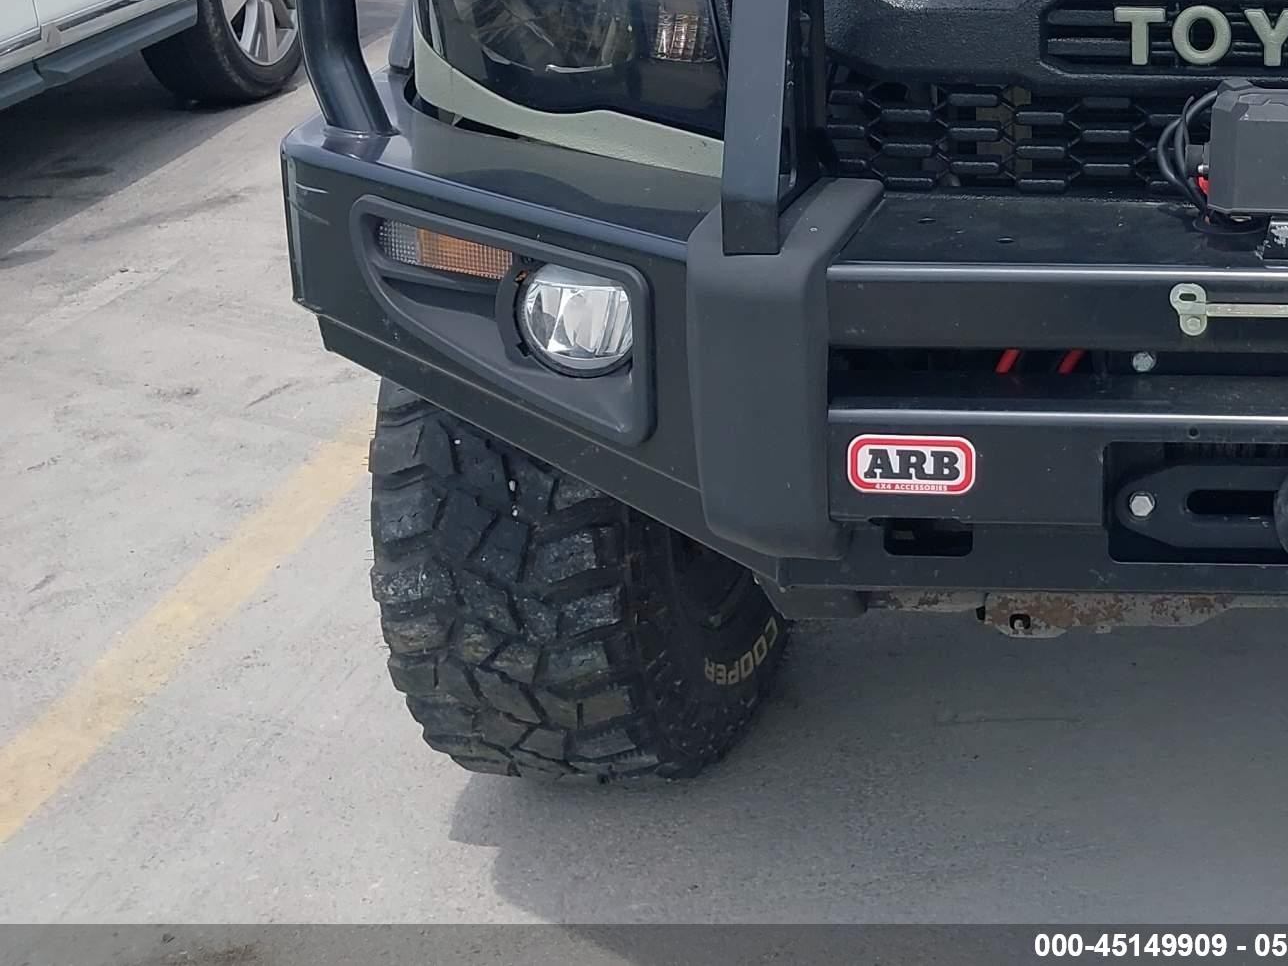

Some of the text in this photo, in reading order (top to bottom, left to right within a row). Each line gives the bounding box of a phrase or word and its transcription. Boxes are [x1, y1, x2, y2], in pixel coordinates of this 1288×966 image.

[863, 448, 961, 481] ARB
[894, 484, 948, 492] ACCESSORIES
[704, 616, 778, 685] COOPER
